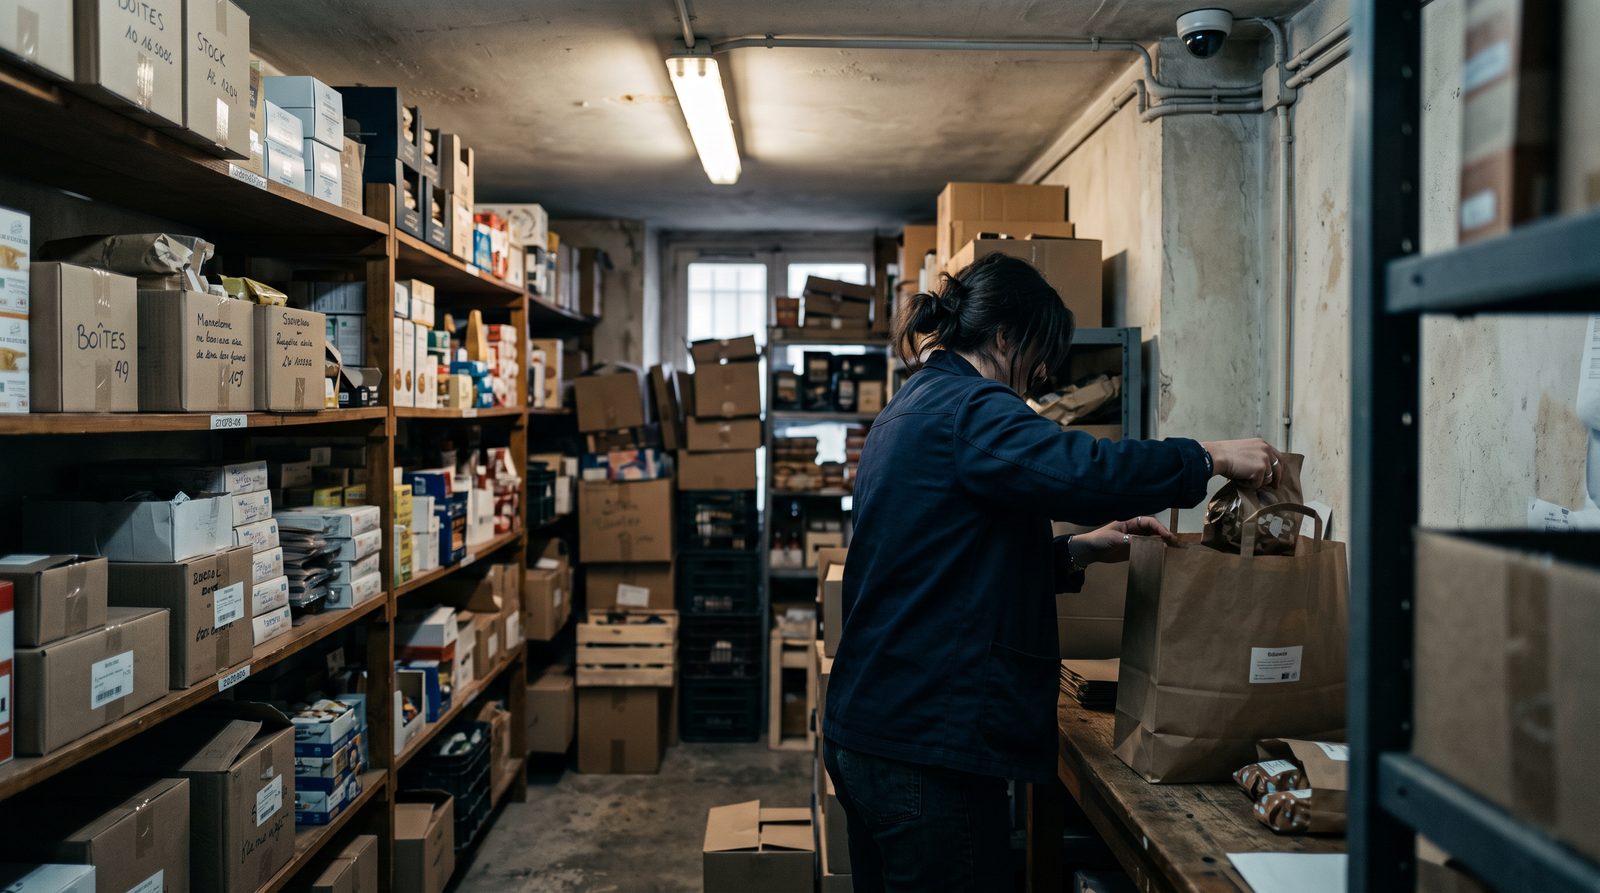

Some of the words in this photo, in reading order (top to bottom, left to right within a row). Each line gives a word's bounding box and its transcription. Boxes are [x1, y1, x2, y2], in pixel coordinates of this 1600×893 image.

[125, 25, 138, 43] 10
[197, 31, 226, 67] STOCK
[221, 78, 238, 104] 1204
[77, 322, 126, 350] BOÎTES
[115, 360, 129, 383] 49
